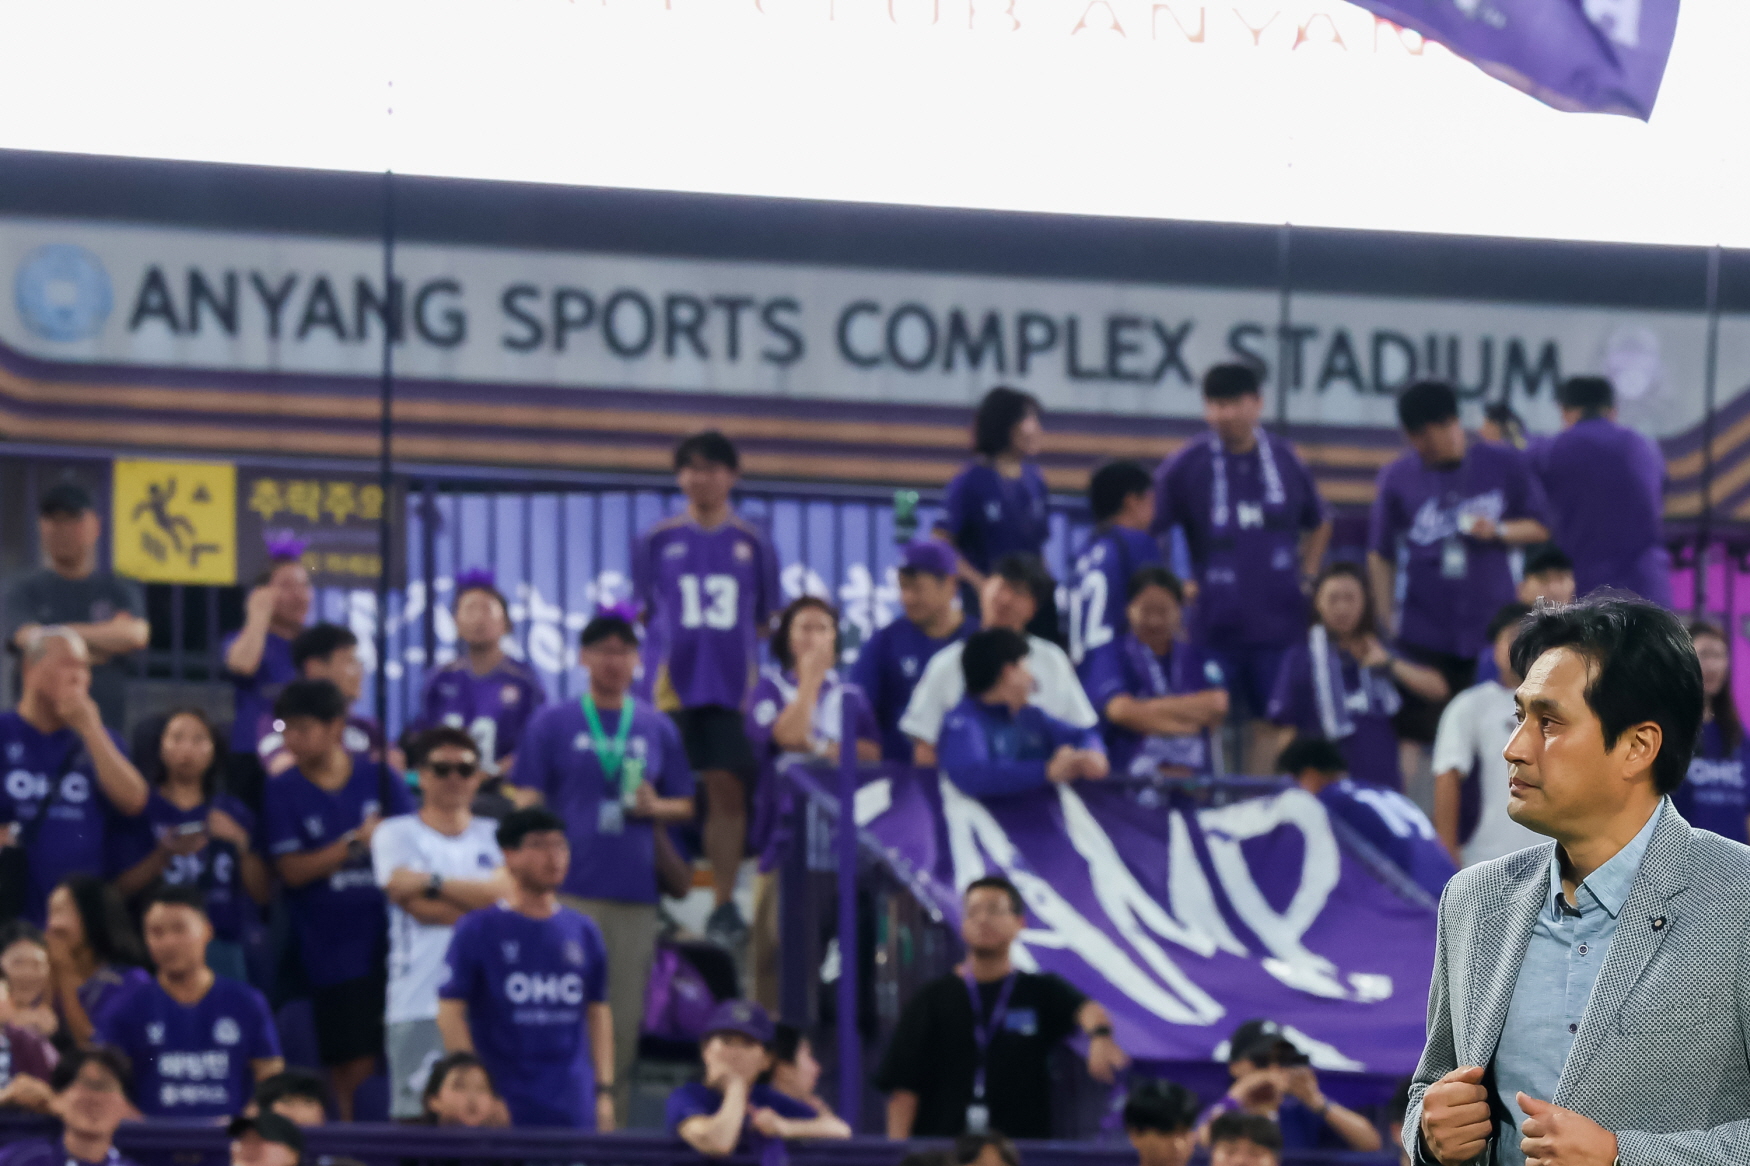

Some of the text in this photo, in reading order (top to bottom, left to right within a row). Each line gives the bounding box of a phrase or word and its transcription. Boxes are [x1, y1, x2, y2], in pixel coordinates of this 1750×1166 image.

[1071, 0, 1424, 56] ANYAN
[129, 265, 1563, 403] ANYANG SPORTS COMPLEX STADIUM
[680, 574, 738, 629] 13
